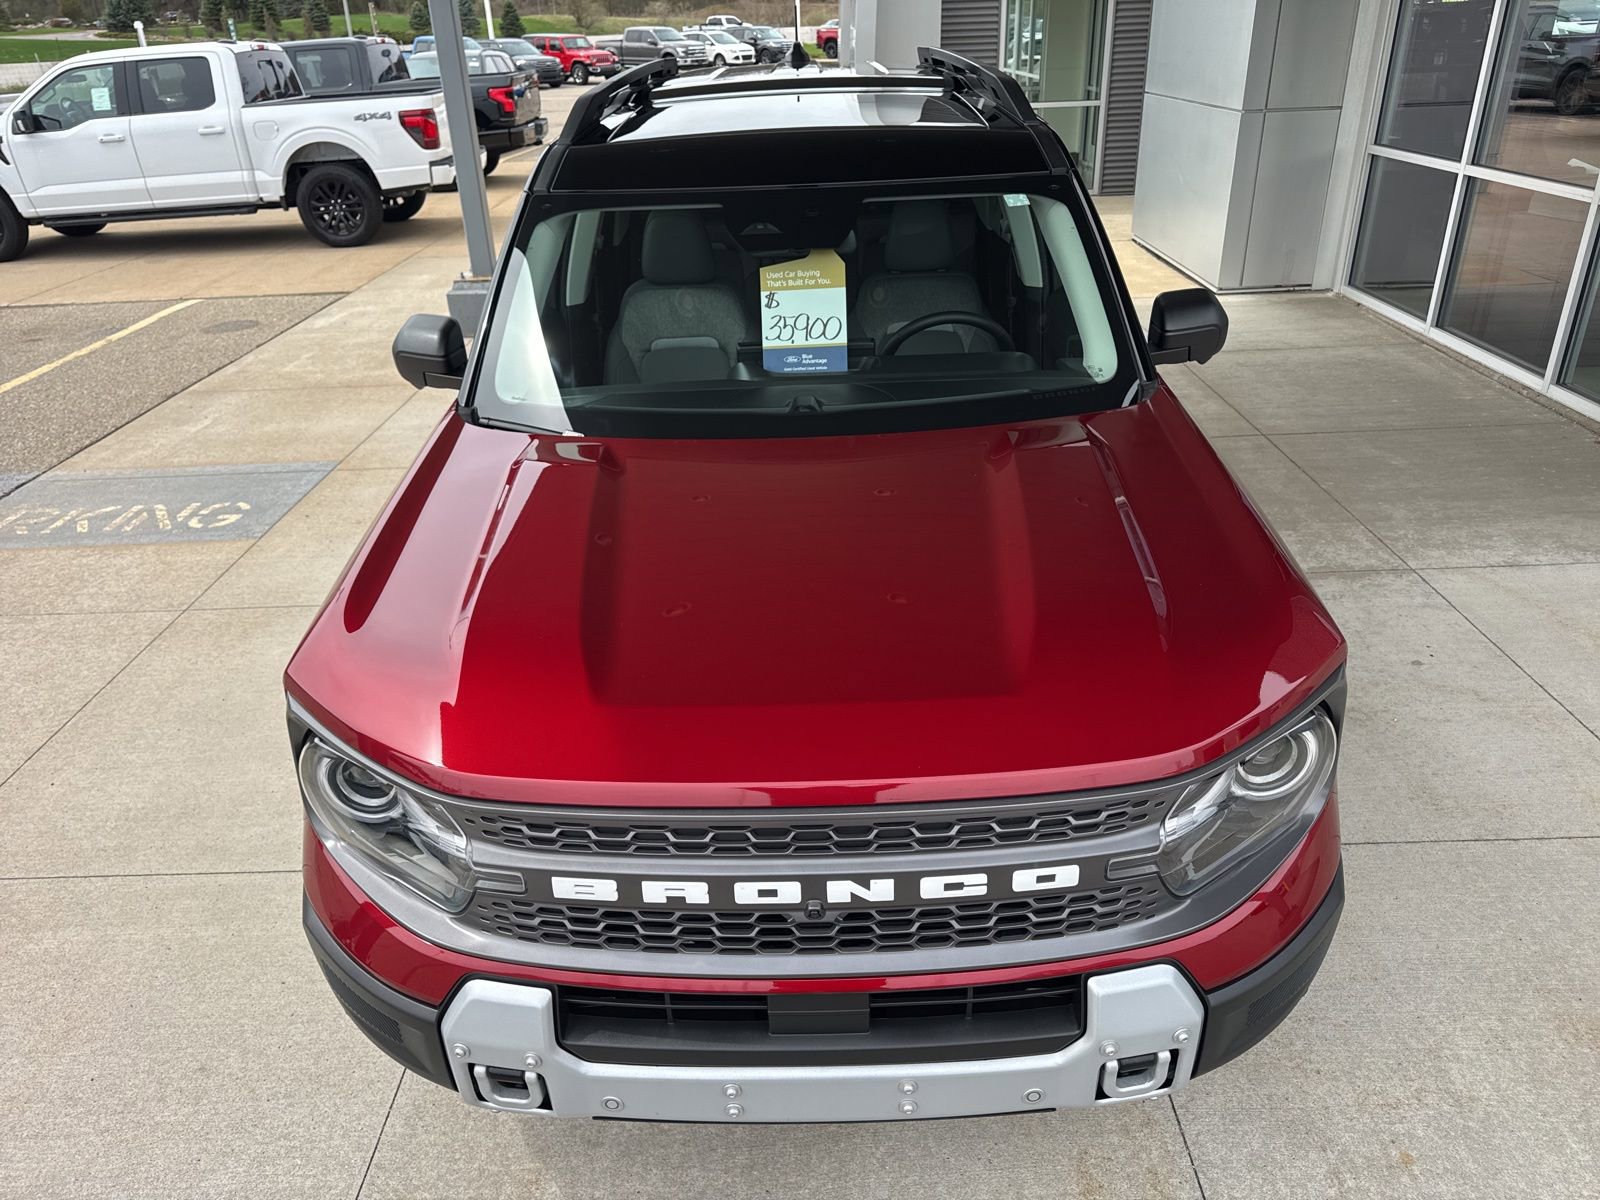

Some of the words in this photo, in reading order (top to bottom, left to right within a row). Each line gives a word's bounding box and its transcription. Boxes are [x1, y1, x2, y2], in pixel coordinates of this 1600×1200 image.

[766, 271, 783, 279] Used
[767, 280, 787, 288] That's
[788, 279, 803, 287] Built
[765, 291, 780, 309] $
[551, 864, 1080, 904] BRONCO
